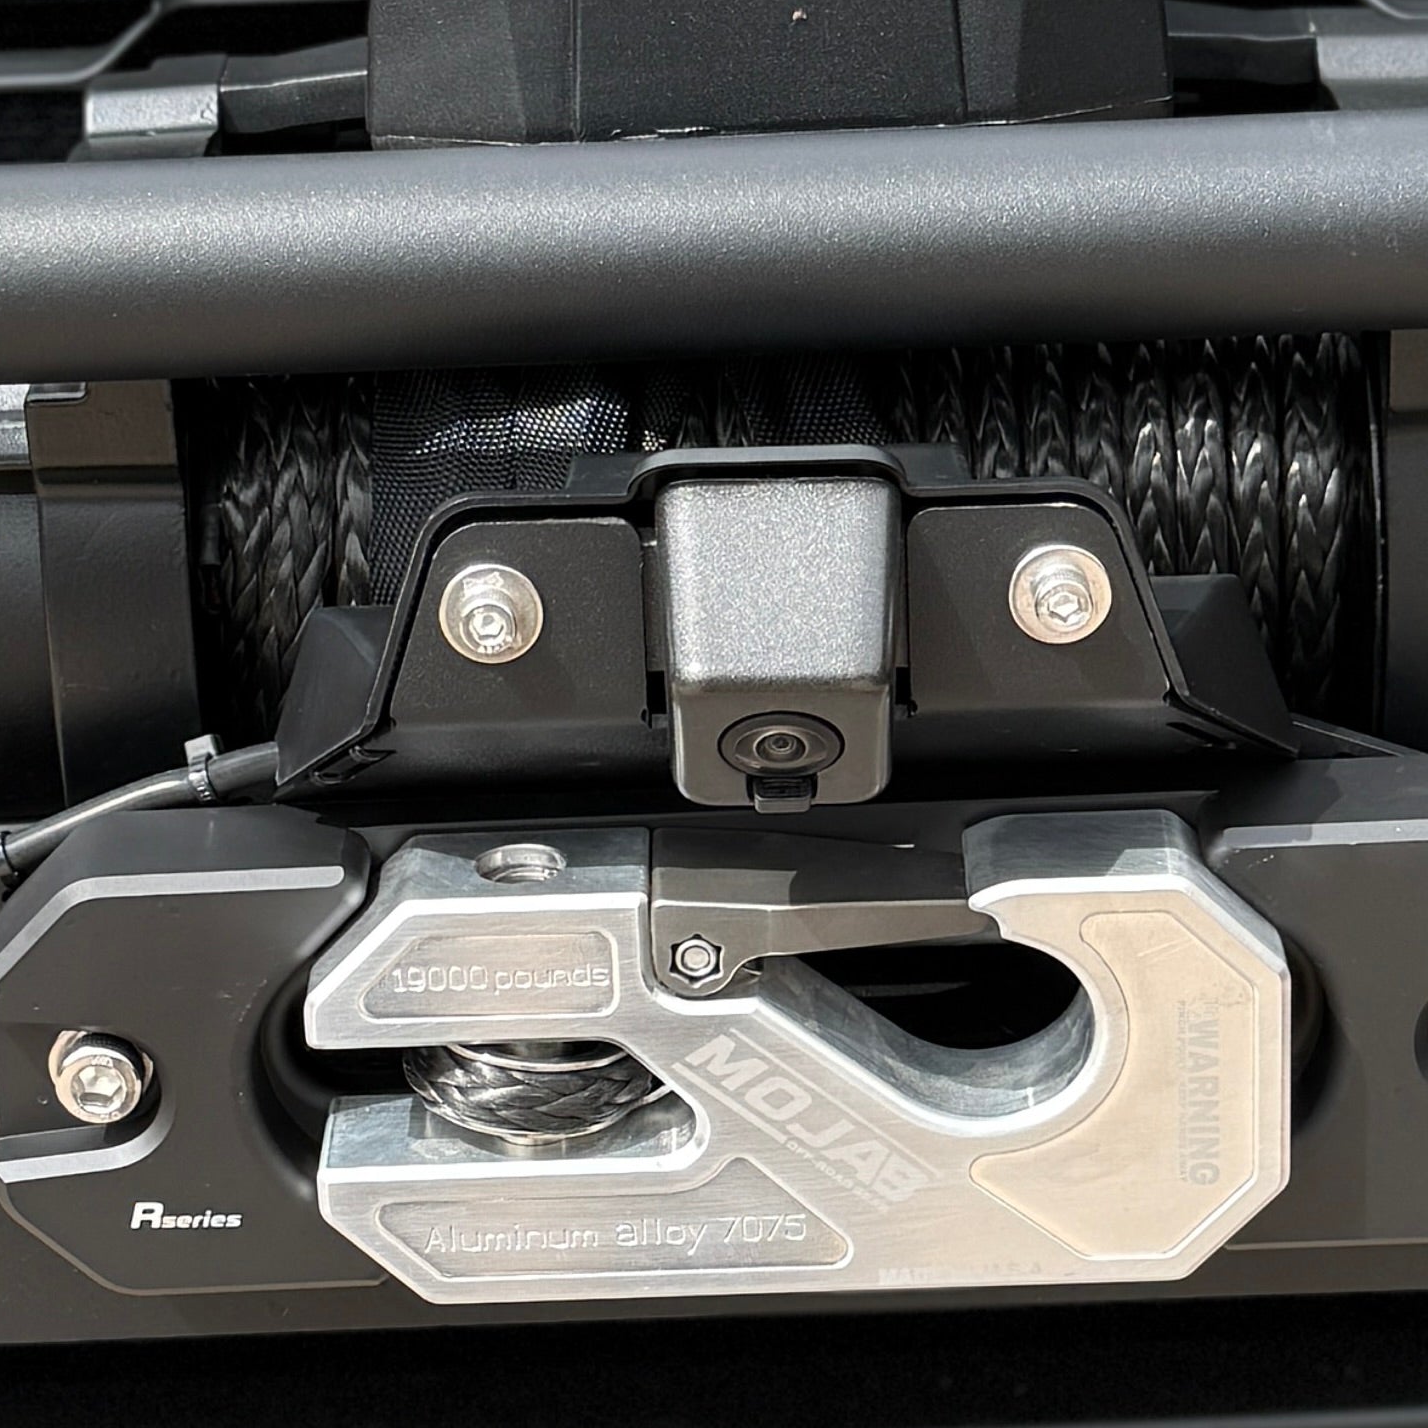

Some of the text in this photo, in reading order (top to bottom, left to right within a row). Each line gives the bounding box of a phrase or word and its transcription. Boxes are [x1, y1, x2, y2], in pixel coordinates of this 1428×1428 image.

[392, 962, 611, 996] 19000 pounds
[684, 1034, 929, 1202] MOJAB
[1187, 1019, 1221, 1187] WARNING
[423, 1213, 807, 1256] Aluminum alloy 7075
